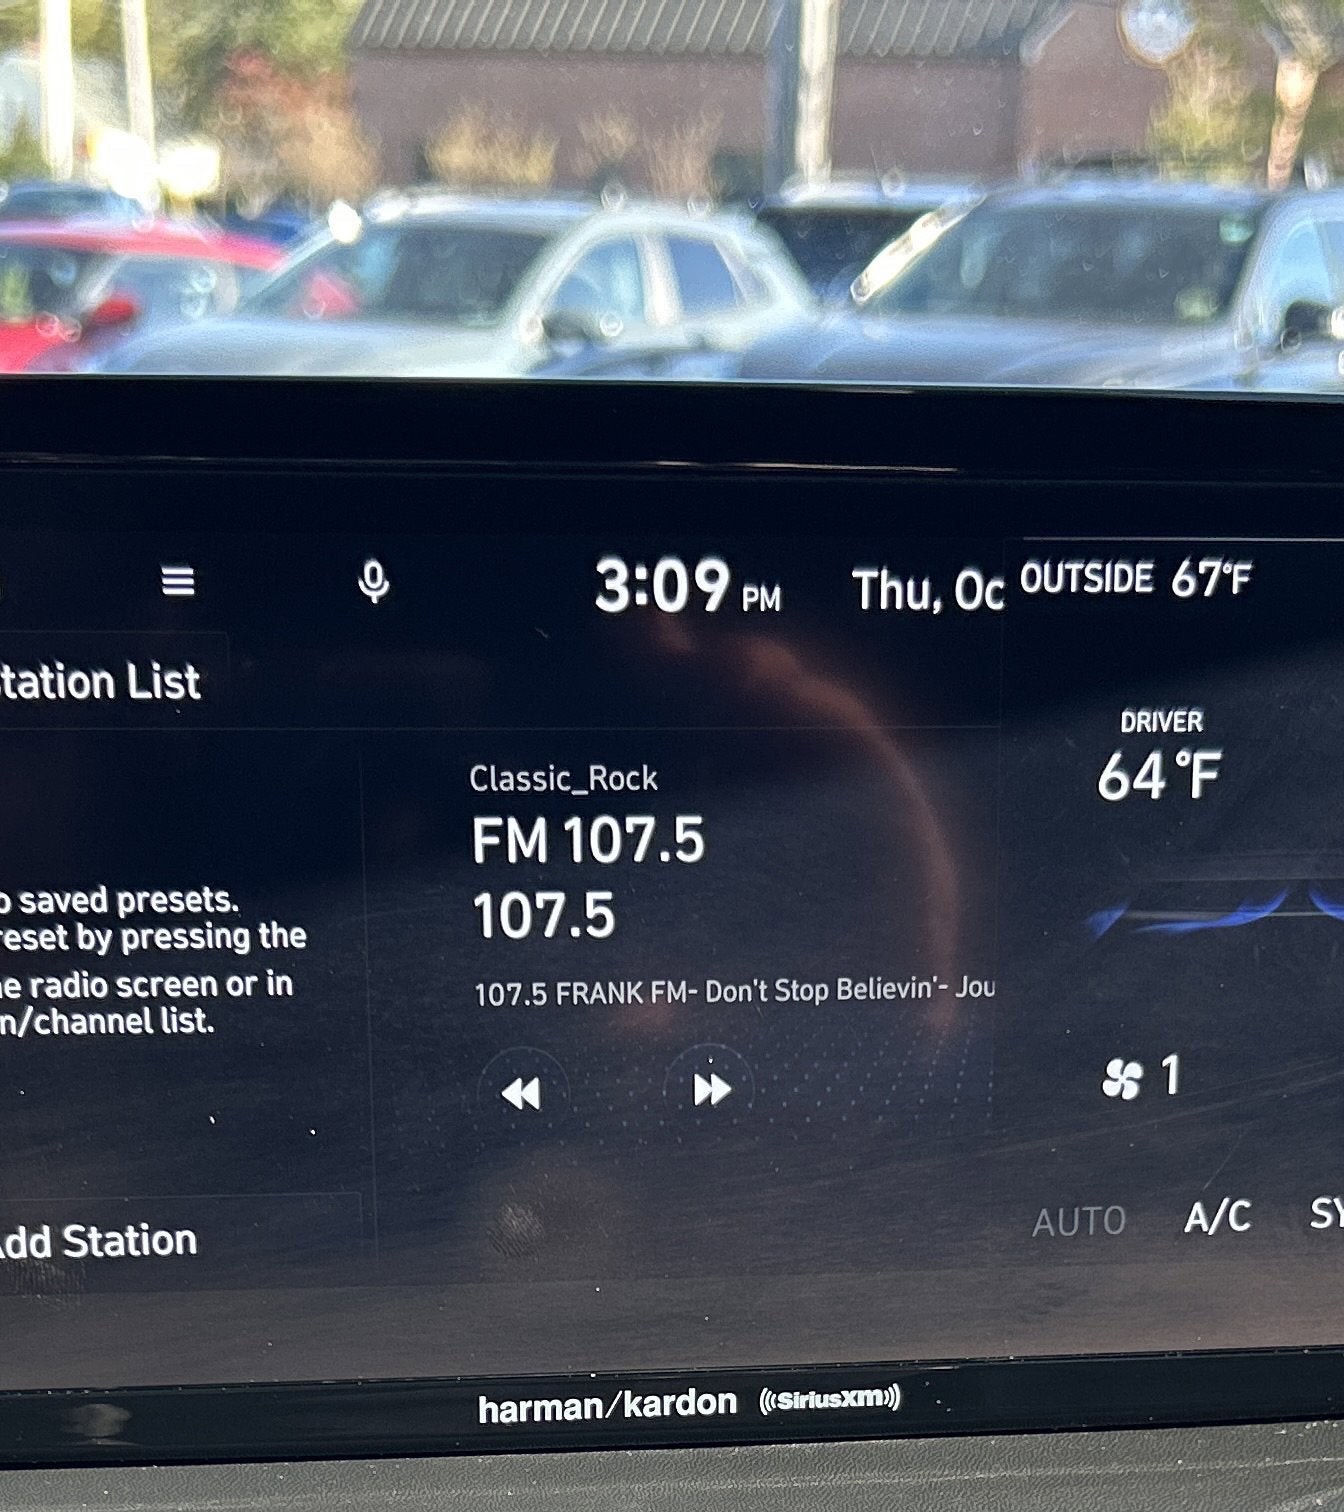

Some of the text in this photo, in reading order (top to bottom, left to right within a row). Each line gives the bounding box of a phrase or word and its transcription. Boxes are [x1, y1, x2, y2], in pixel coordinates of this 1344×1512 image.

[594, 556, 782, 613] 3:09 PM
[850, 566, 1006, 616] Thu, Oc
[1019, 559, 1155, 595] OUTSIDE
[126, 660, 203, 701] List
[1120, 708, 1205, 734] DRIVER
[468, 763, 660, 797] Classic_Rock
[472, 814, 706, 865] FM 107.5
[18, 884, 109, 915] saved
[116, 885, 240, 919] presets.
[472, 890, 616, 940] 107.5
[75, 920, 113, 957] by
[119, 920, 252, 957] pressing
[257, 919, 309, 950] the
[29, 969, 110, 1000] radio
[115, 974, 218, 999] screen
[225, 975, 260, 998] or
[265, 967, 294, 997] in
[474, 981, 549, 1008] 107.5
[555, 979, 645, 1007] FRANK
[705, 977, 770, 1004] Don't
[773, 977, 830, 1007] Stop
[954, 974, 997, 999] Jou
[159, 1004, 216, 1036] list.
[1160, 1052, 1181, 1096] 1
[1031, 1204, 1128, 1239] AUTO
[1183, 1196, 1254, 1237] A/C
[61, 1221, 198, 1259] Station
[477, 1387, 738, 1425] harman/kardon
